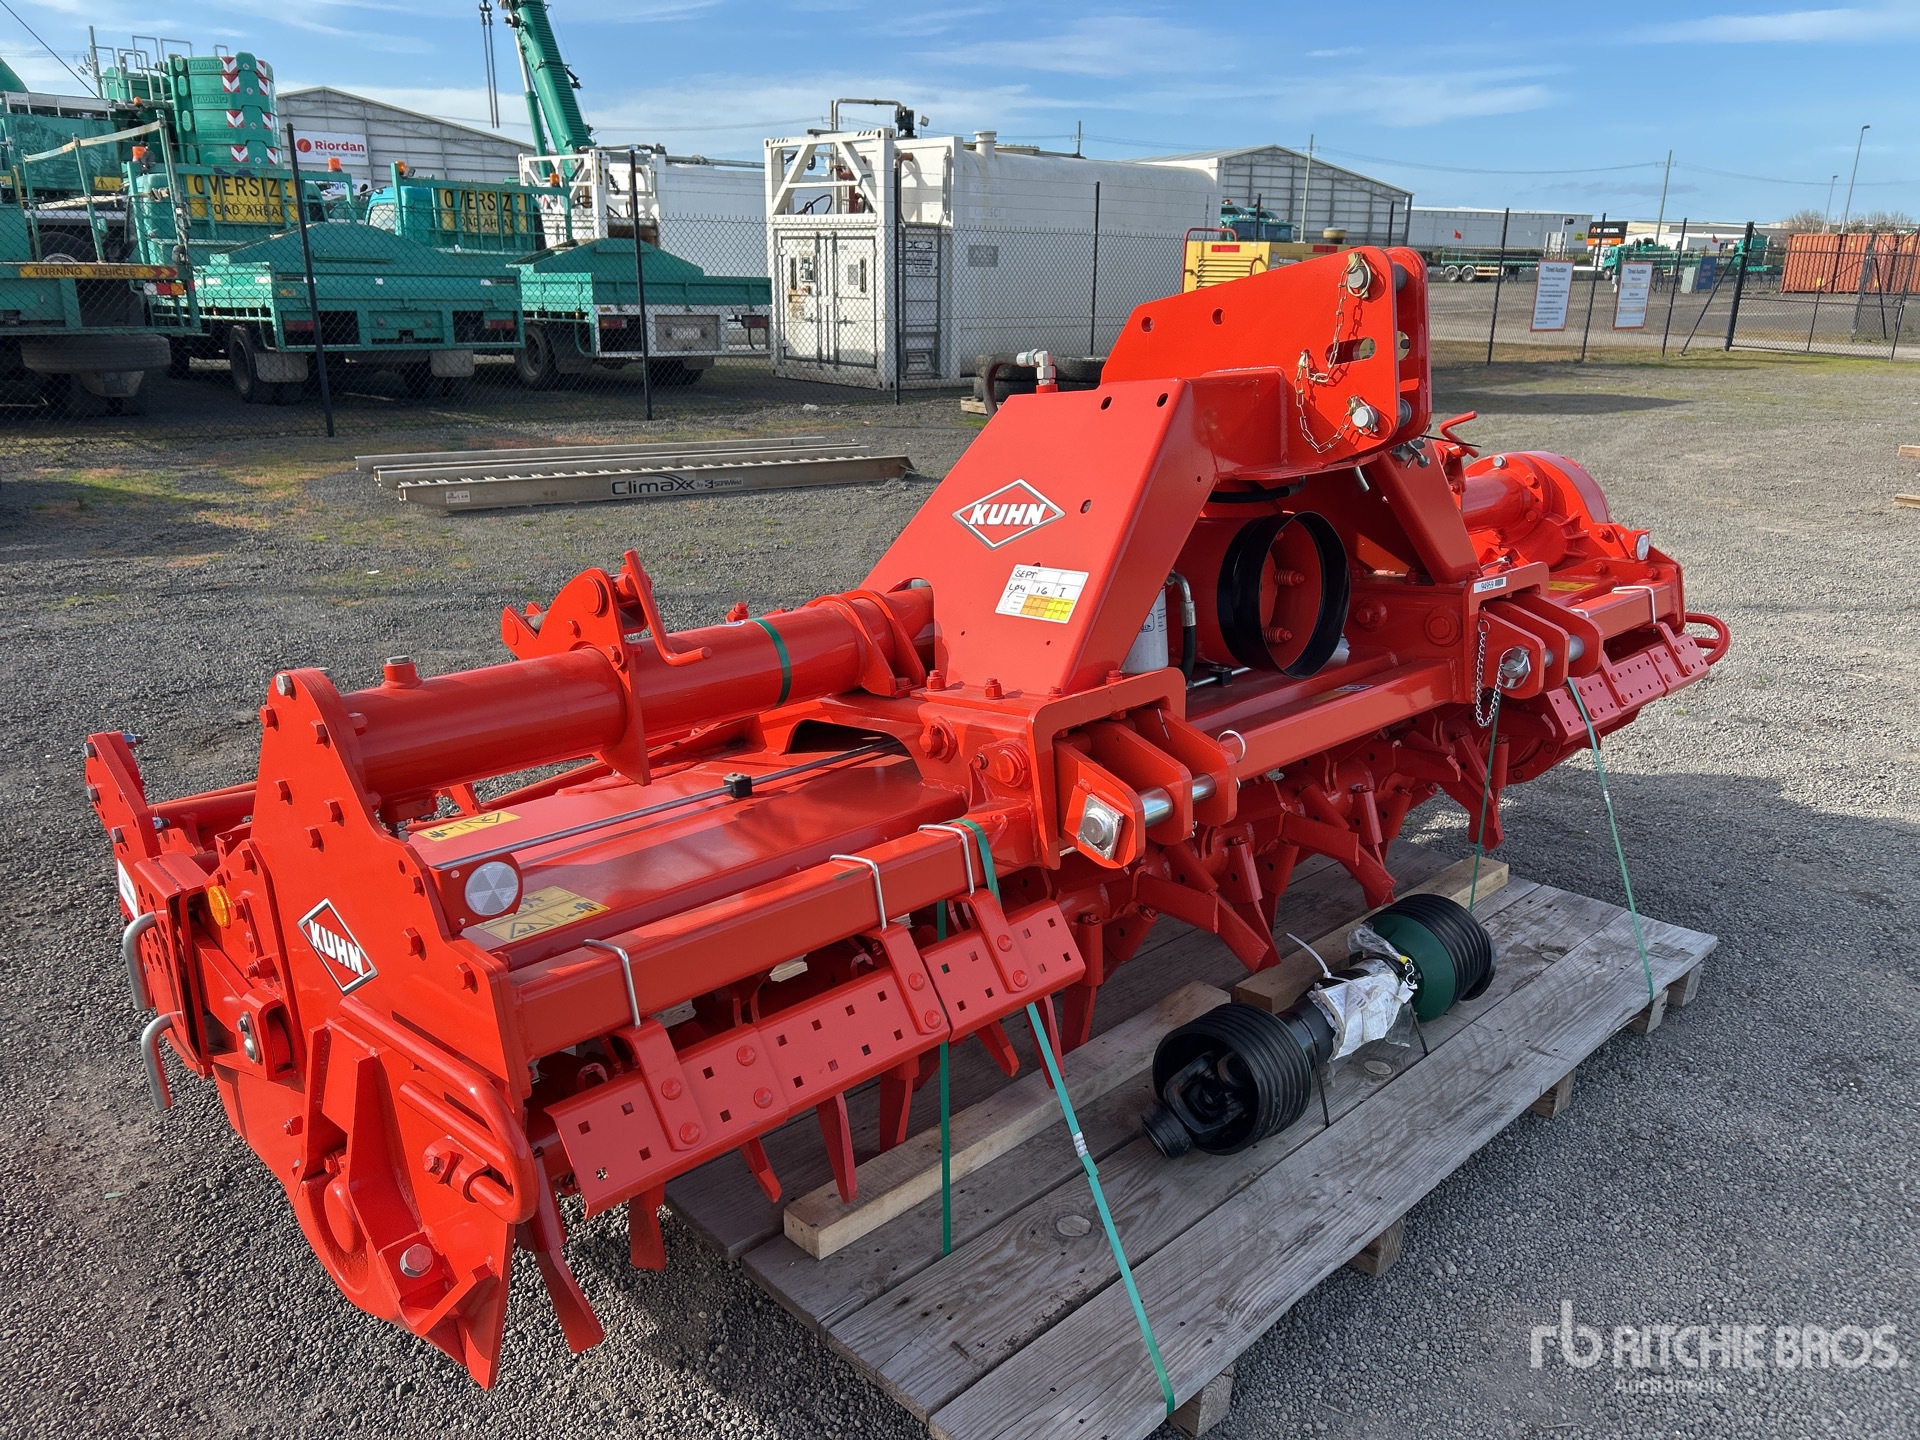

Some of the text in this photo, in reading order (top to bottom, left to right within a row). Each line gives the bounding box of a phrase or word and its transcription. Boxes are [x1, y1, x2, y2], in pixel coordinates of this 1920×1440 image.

[314, 140, 365, 152] Riordan
[445, 190, 521, 212] OVERSZ
[213, 203, 240, 216] OAD
[34, 266, 136, 276] TURNING VEHICLE
[968, 503, 1047, 526] KUHN
[1014, 569, 1038, 579] SEPT
[1036, 586, 1048, 595] 16
[309, 918, 364, 978] KUHN
